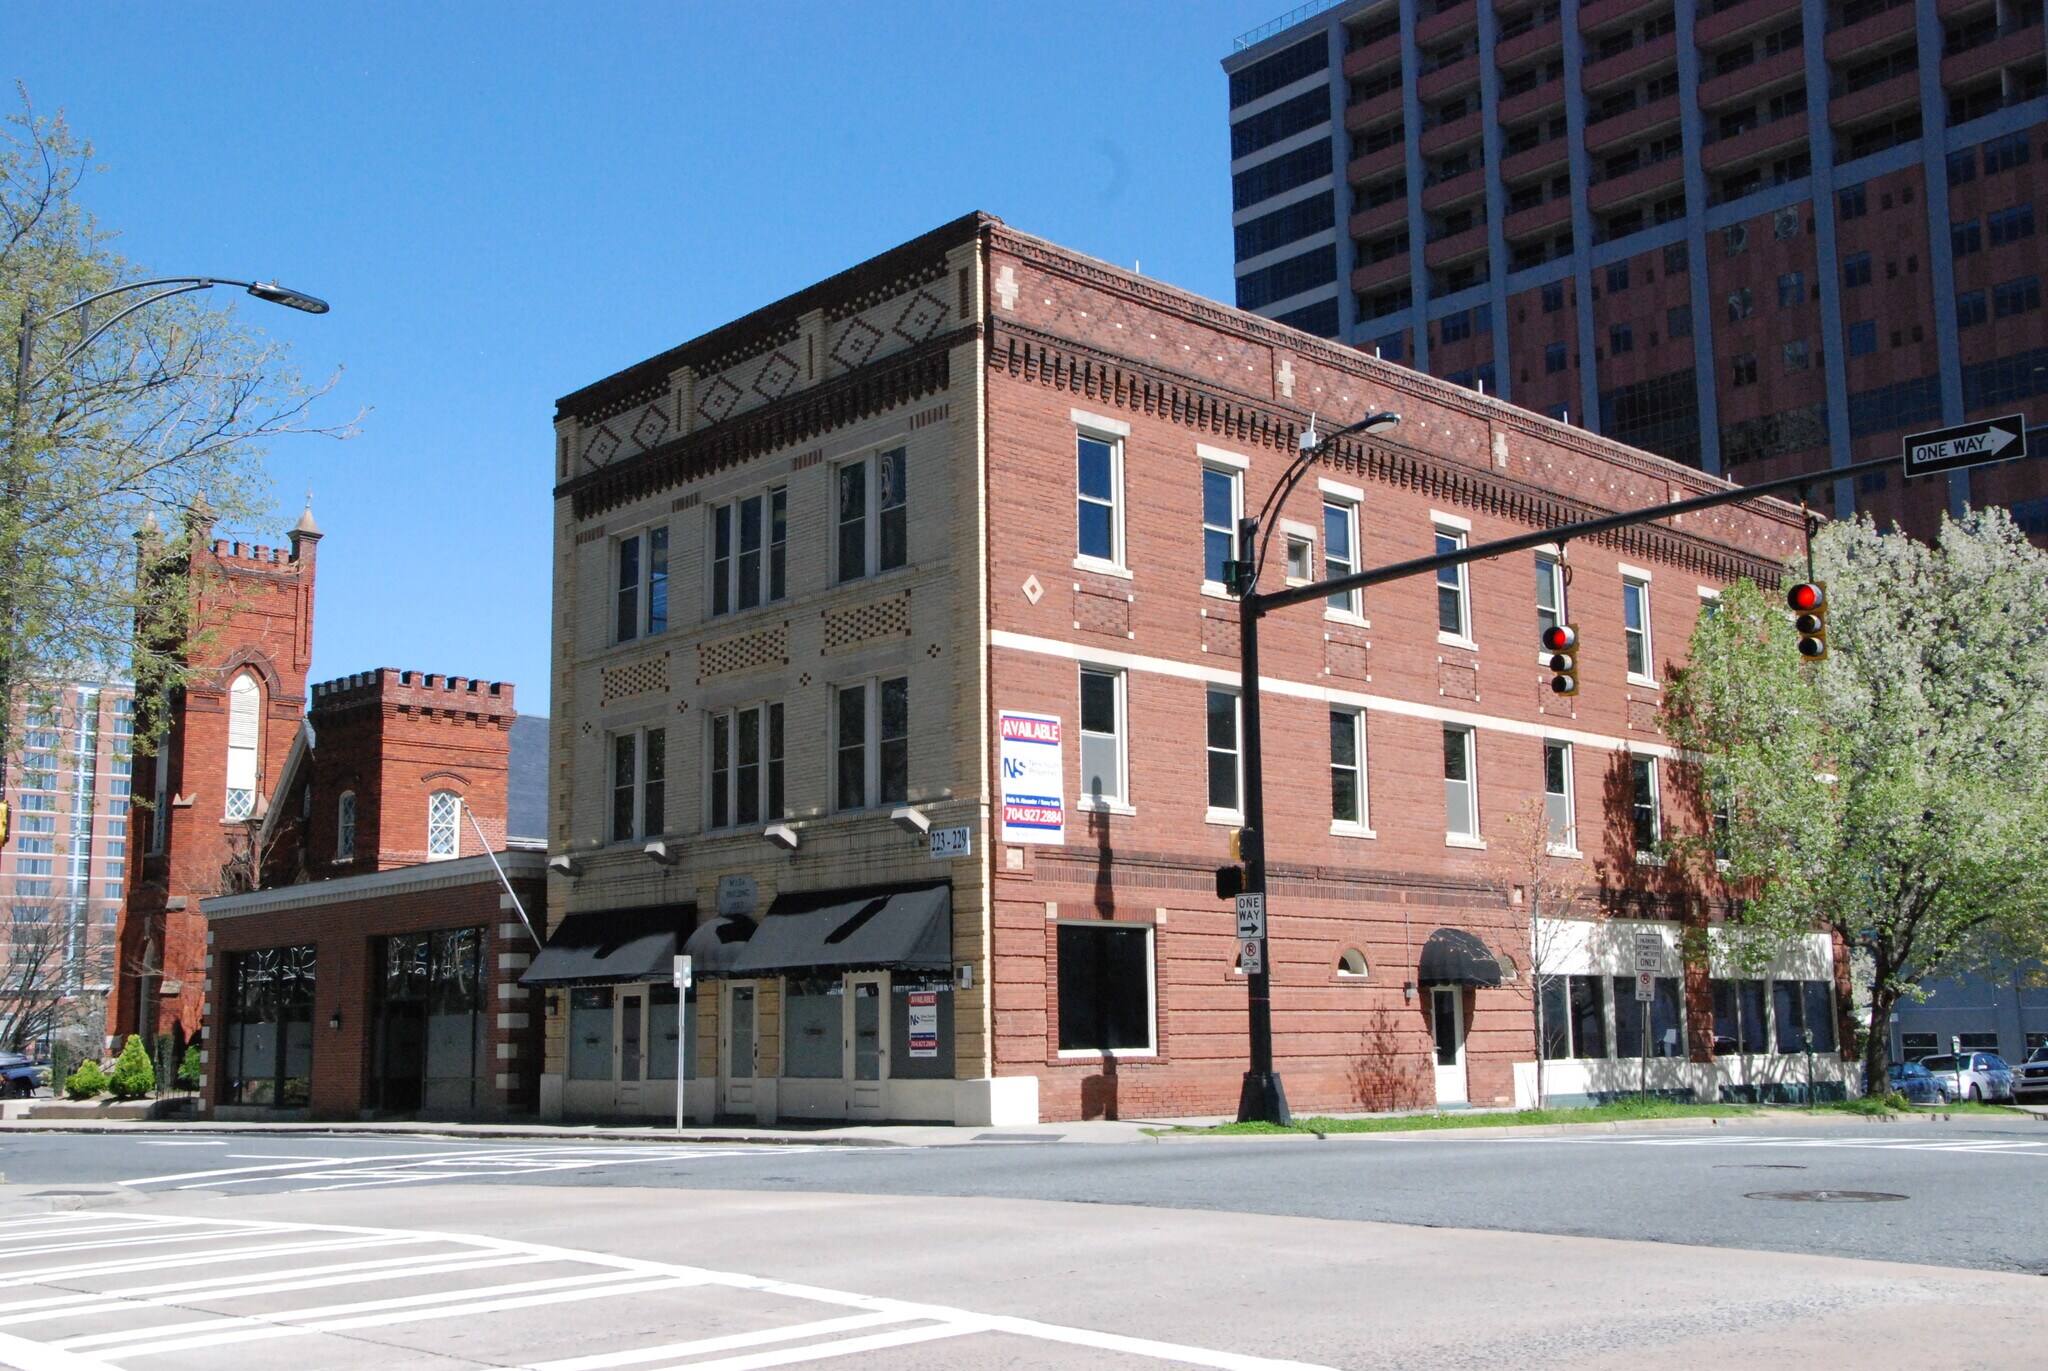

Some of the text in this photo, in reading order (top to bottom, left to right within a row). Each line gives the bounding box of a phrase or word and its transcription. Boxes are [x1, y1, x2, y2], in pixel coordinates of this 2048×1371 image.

[1916, 435, 1986, 461] ONE WAY
[1003, 720, 1059, 740] AVAILABLE
[1004, 757, 1026, 778] NS
[1006, 807, 1062, 823] 704.927.2884
[931, 831, 946, 851] 223
[952, 829, 967, 849] 229
[1239, 898, 1259, 908] ONE
[1239, 910, 1259, 920] WAY
[1640, 958, 1657, 967] ONLY
[911, 995, 935, 1003] AVAILABLE
